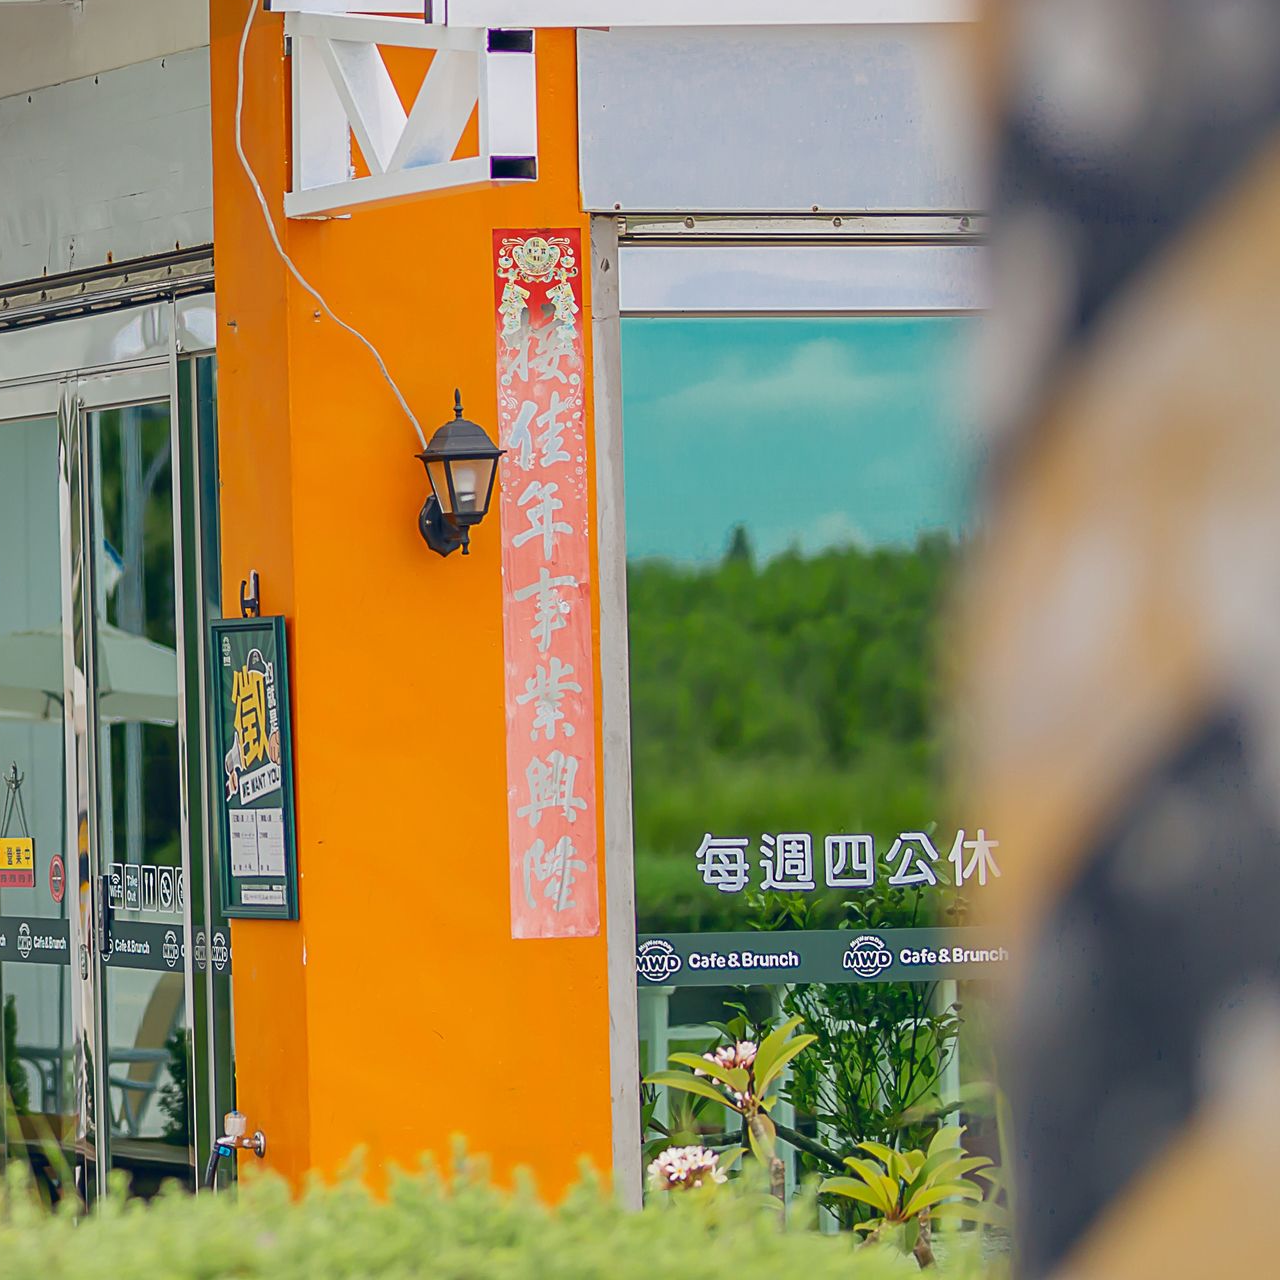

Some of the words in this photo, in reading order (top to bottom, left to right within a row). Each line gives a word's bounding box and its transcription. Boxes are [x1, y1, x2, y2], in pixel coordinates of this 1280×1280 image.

[695, 828, 1002, 892] 每週四公休
[126, 875, 139, 887] Take
[126, 889, 137, 902] Out
[636, 954, 682, 973] MWD
[842, 950, 893, 969] MWD
